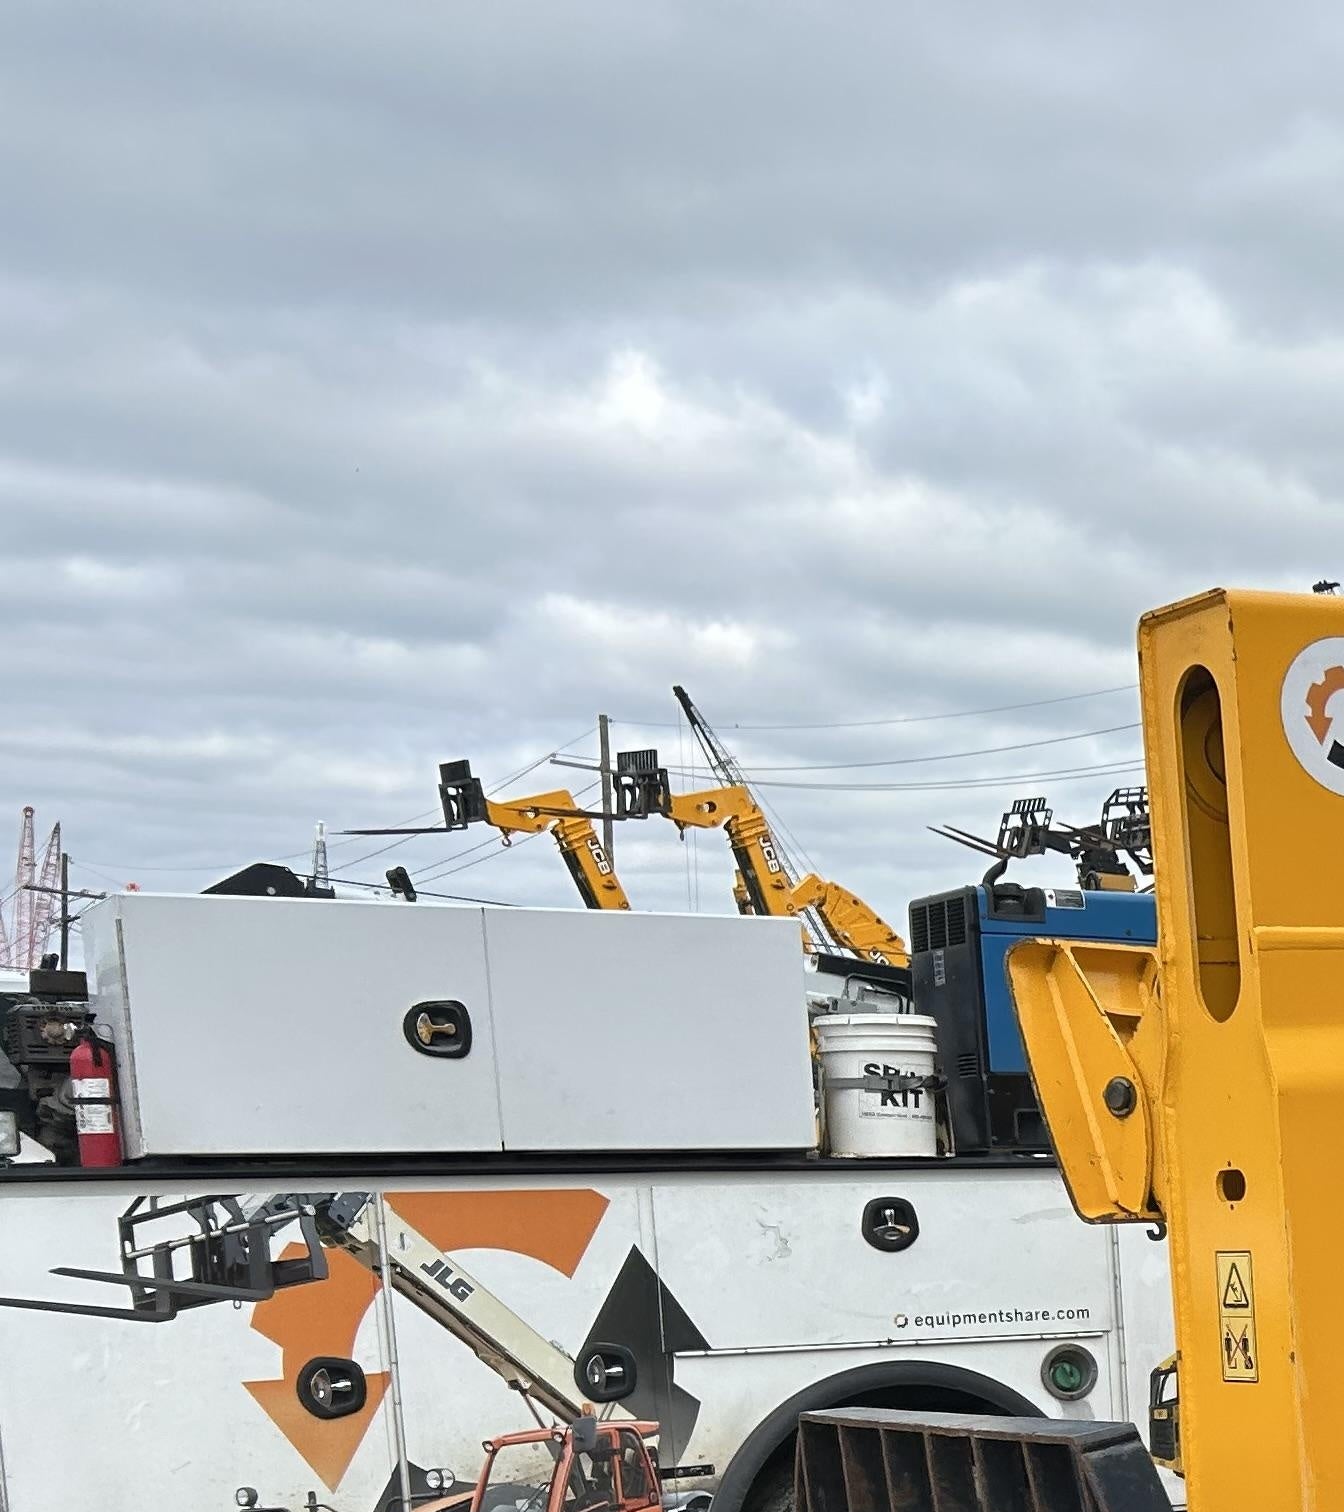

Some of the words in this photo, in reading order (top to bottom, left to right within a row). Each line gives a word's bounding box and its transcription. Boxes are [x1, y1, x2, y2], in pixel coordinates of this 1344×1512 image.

[587, 839, 611, 875] JCB
[759, 837, 780, 873] JCB
[881, 1089, 923, 1108] KIT
[420, 1259, 475, 1302] JLG
[914, 1308, 1090, 1328] equipmentshare.com
